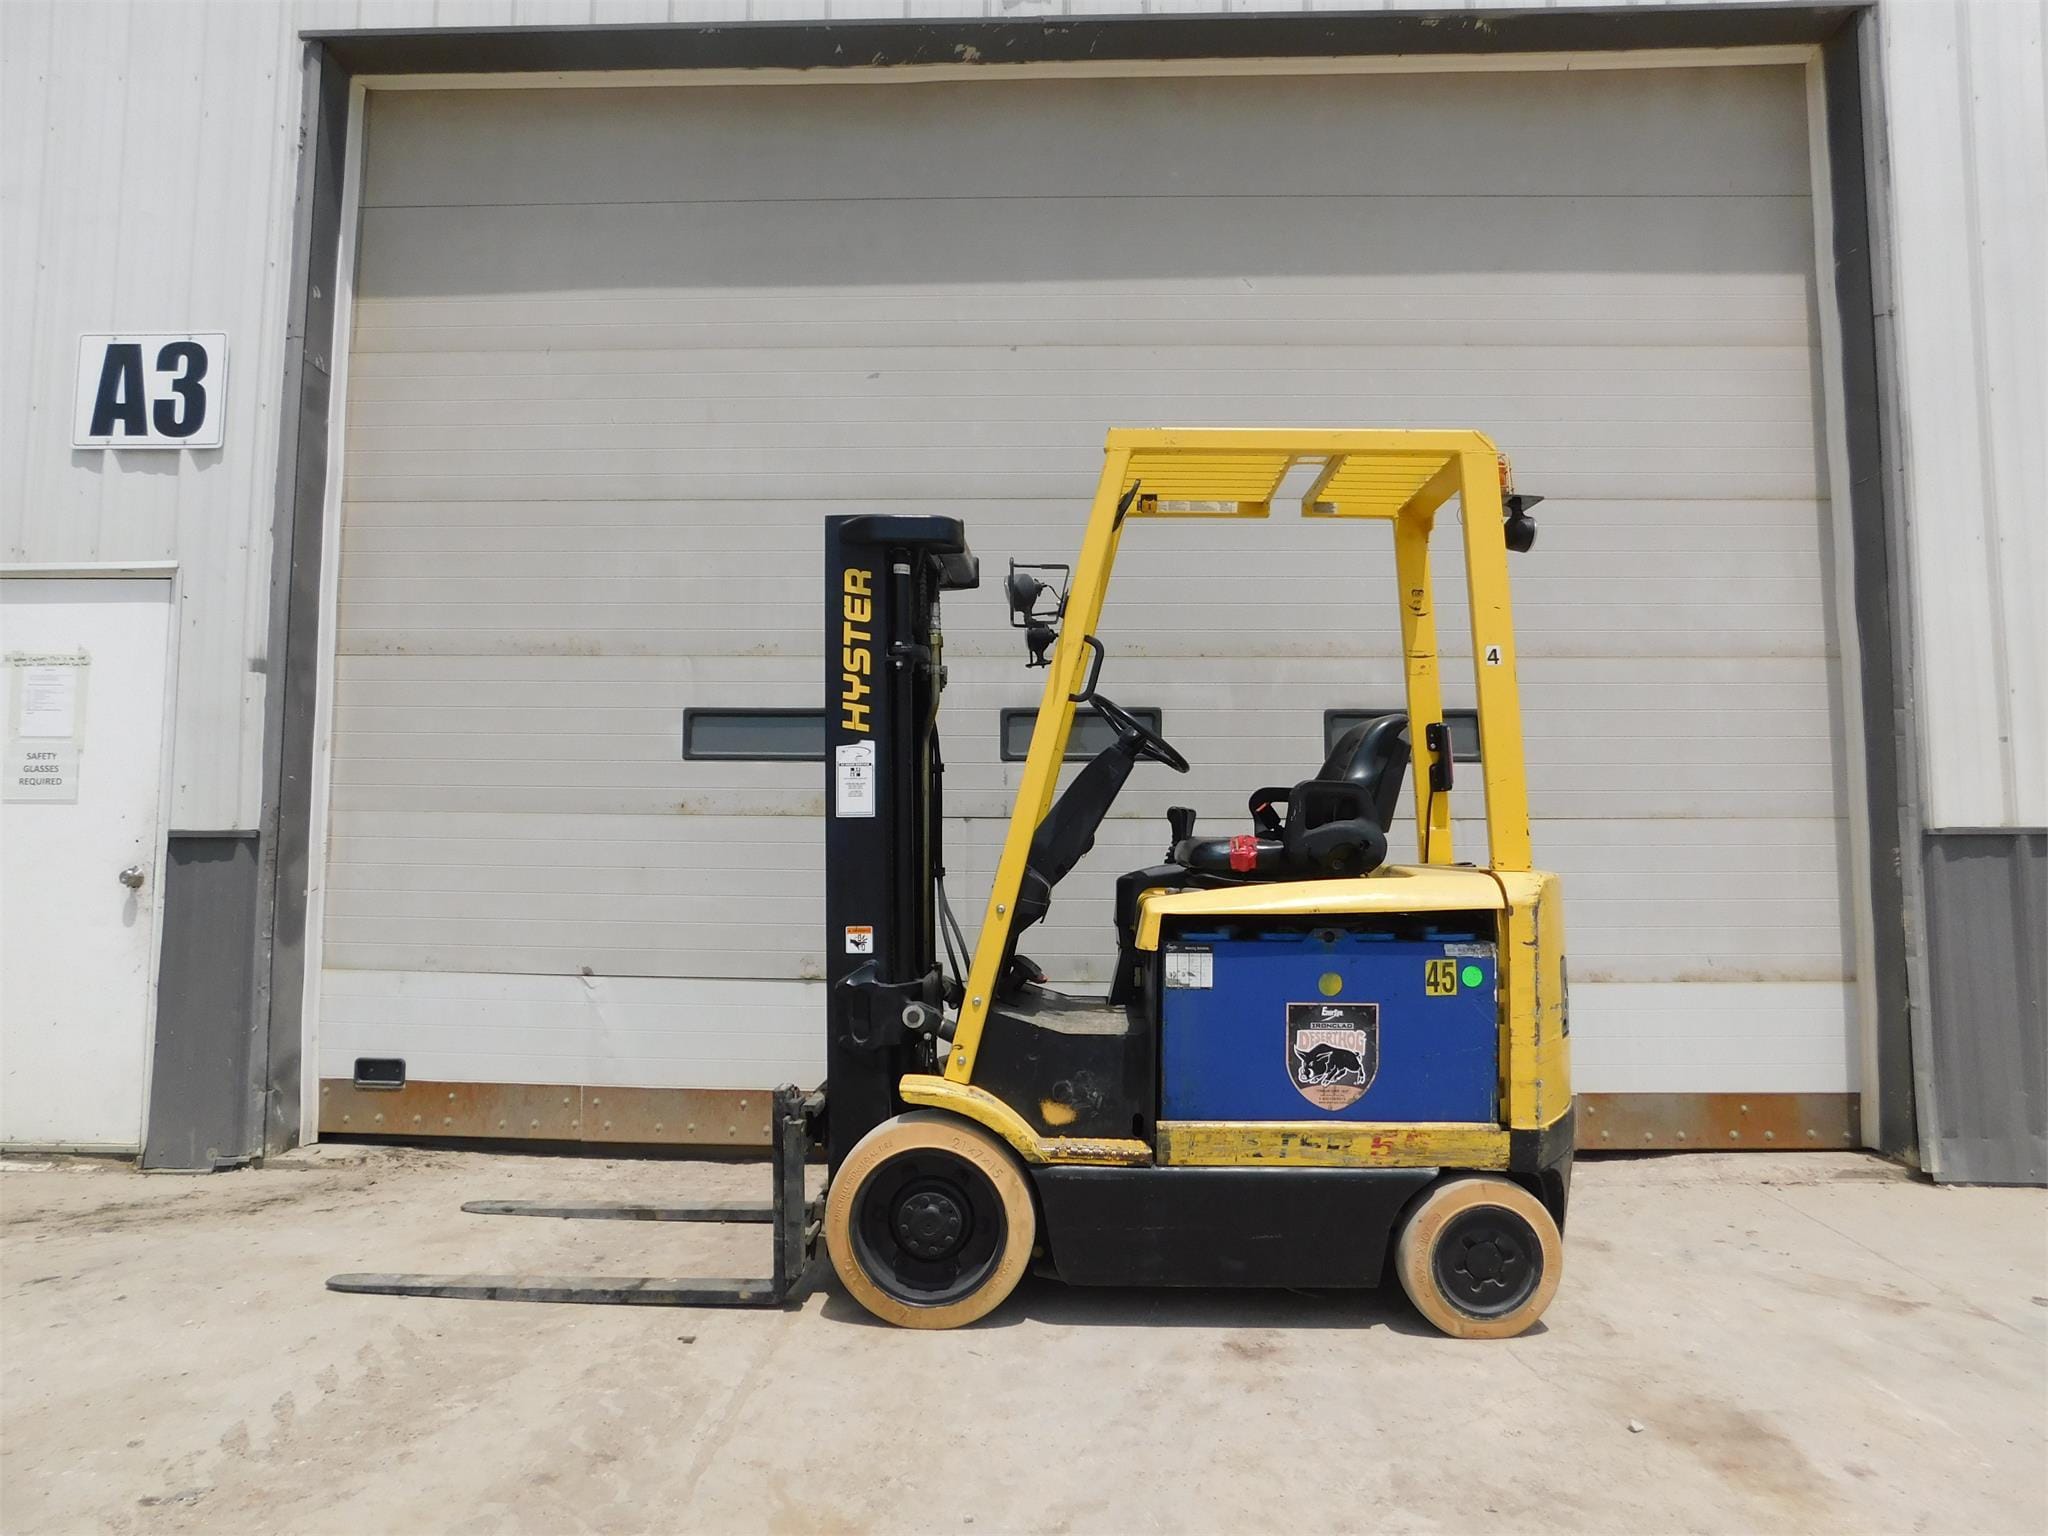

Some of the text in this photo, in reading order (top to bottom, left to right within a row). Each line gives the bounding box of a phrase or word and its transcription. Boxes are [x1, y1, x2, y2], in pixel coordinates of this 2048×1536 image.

[89, 341, 208, 438] A3
[842, 568, 872, 733] HYSTER
[1487, 648, 1500, 665] 4
[23, 765, 59, 773] GLASSES
[26, 752, 58, 760] SAFETY
[1426, 961, 1455, 993] 45
[1297, 1030, 1366, 1056] DESERTHOG
